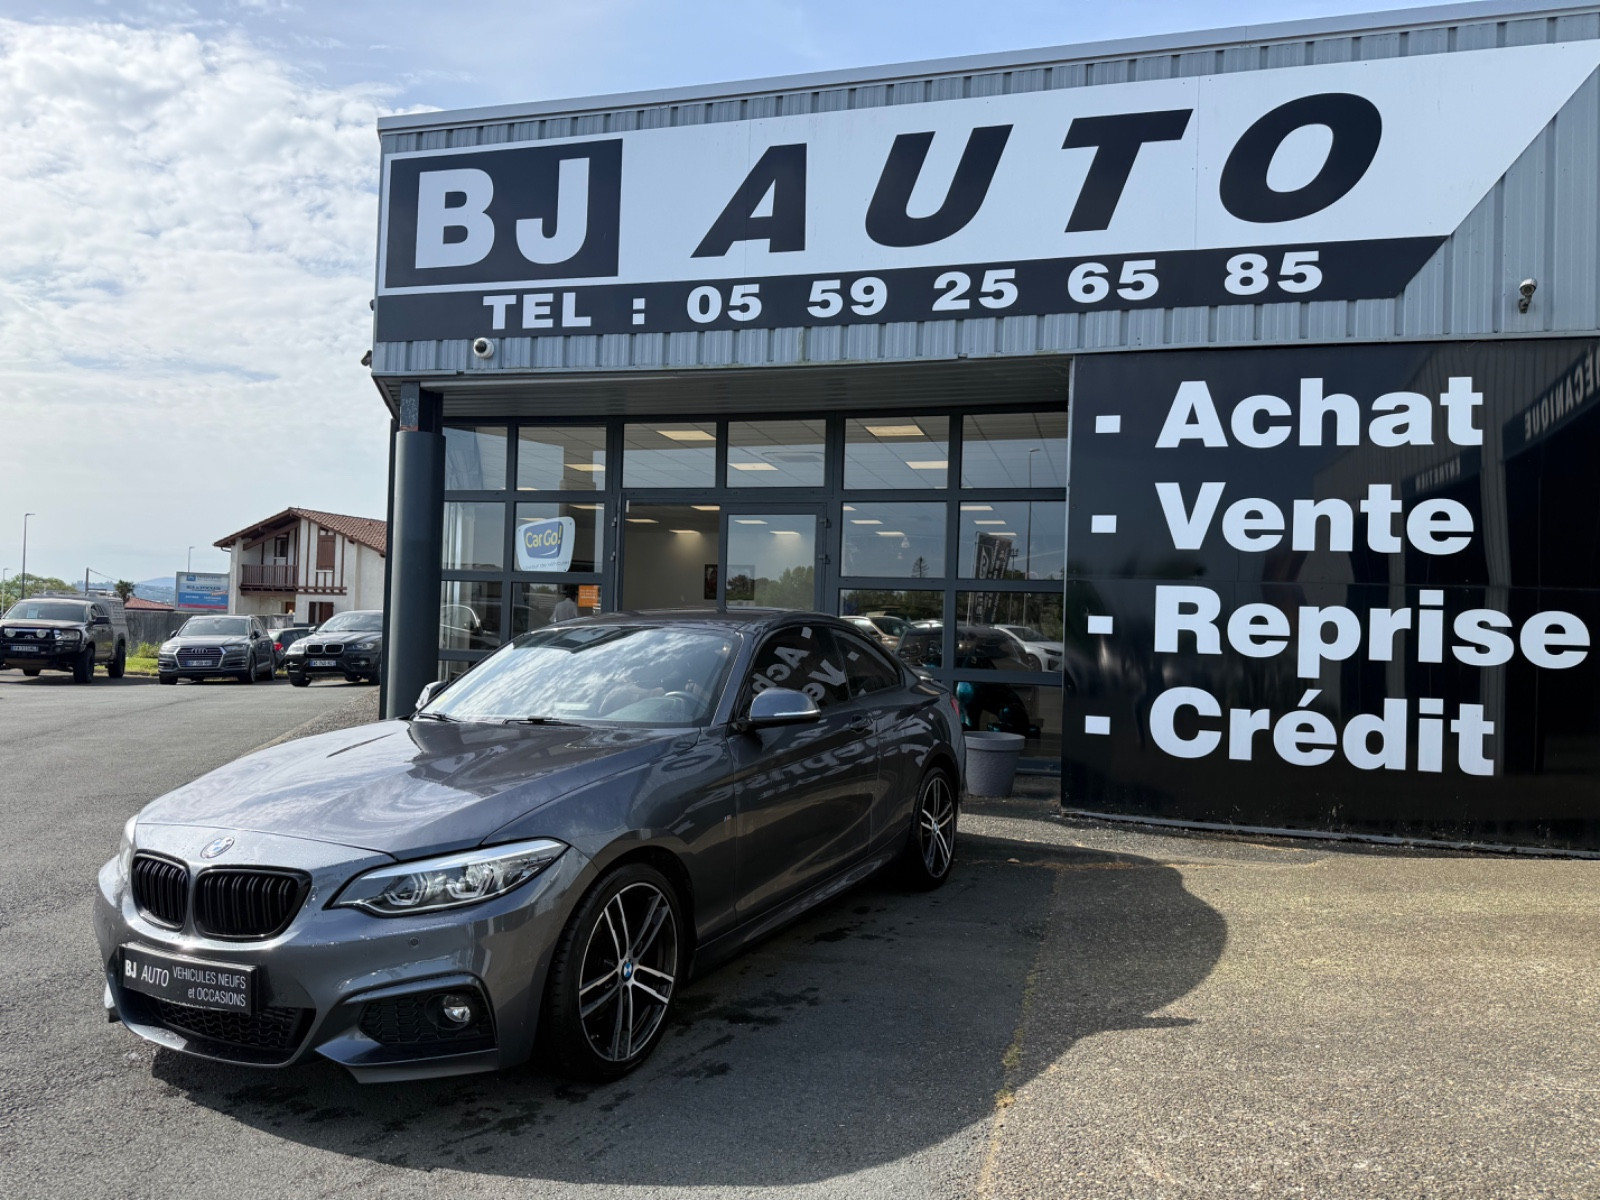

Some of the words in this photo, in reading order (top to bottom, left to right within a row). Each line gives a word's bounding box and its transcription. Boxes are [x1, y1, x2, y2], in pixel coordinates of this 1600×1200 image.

[415, 157, 590, 270] BJ
[690, 92, 1383, 259] AUTO
[482, 292, 592, 330] TEL
[686, 283, 762, 324] 05
[807, 276, 888, 318] 59
[931, 268, 1019, 312] 25
[1067, 259, 1160, 304] 65
[1224, 250, 1323, 296] 85
[1154, 376, 1484, 449] Achat
[1154, 481, 1474, 555] Vente
[1154, 585, 1591, 679] Reprise
[1149, 689, 1495, 776] Crédit
[125, 959, 138, 979] BJ
[140, 964, 170, 988] AUTO
[172, 965, 216, 985] VEHICULES
[218, 972, 246, 989] NEUFS
[187, 987, 196, 999] et
[196, 988, 246, 1007] OCCASIONS
